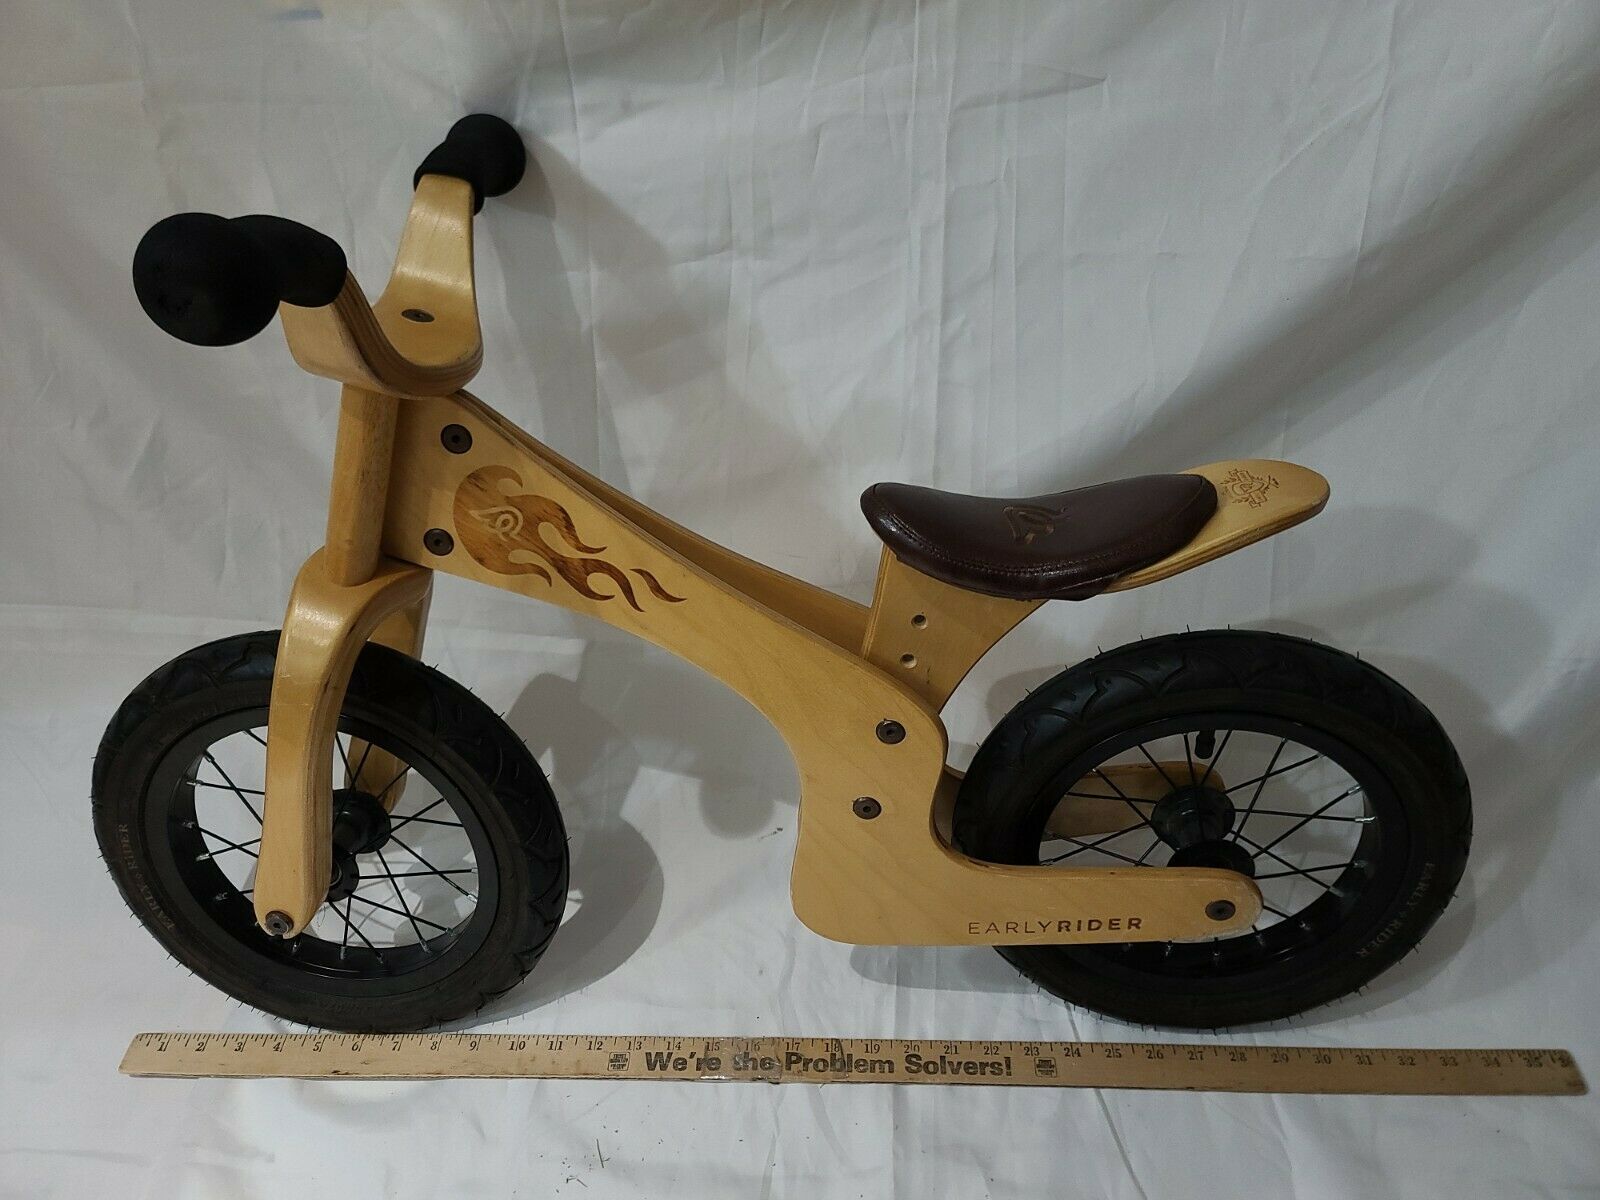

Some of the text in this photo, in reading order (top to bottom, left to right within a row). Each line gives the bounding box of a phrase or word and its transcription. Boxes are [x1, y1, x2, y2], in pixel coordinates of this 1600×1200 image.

[157, 1042, 165, 1052] 1
[195, 1042, 204, 1052] 2
[234, 1042, 243, 1052] 3
[272, 1042, 282, 1052] 4
[312, 1042, 321, 1052] 5
[352, 1042, 360, 1052] 6
[392, 1042, 400, 1051] 7
[430, 1041, 438, 1051] 8
[469, 1041, 477, 1051] 9
[510, 1041, 525, 1051] 10
[548, 1041, 563, 1051] 11
[587, 1041, 603, 1051] 12
[627, 1041, 642, 1051] 13
[666, 1041, 681, 1051] 14
[706, 1041, 720, 1051] 15
[745, 1041, 760, 1051] 16
[785, 1042, 800, 1051] 17
[824, 1043, 840, 1053] 18
[864, 1043, 880, 1054] 19
[904, 1044, 920, 1054] 20
[944, 1044, 959, 1055] 21
[983, 1045, 1000, 1055] 22
[1024, 1046, 1040, 1056] 23
[1064, 1047, 1081, 1057] 24
[645, 1051, 722, 1071] We're
[732, 1052, 774, 1072] the
[785, 1052, 895, 1074] Problem
[904, 1053, 1012, 1076] Solvers!
